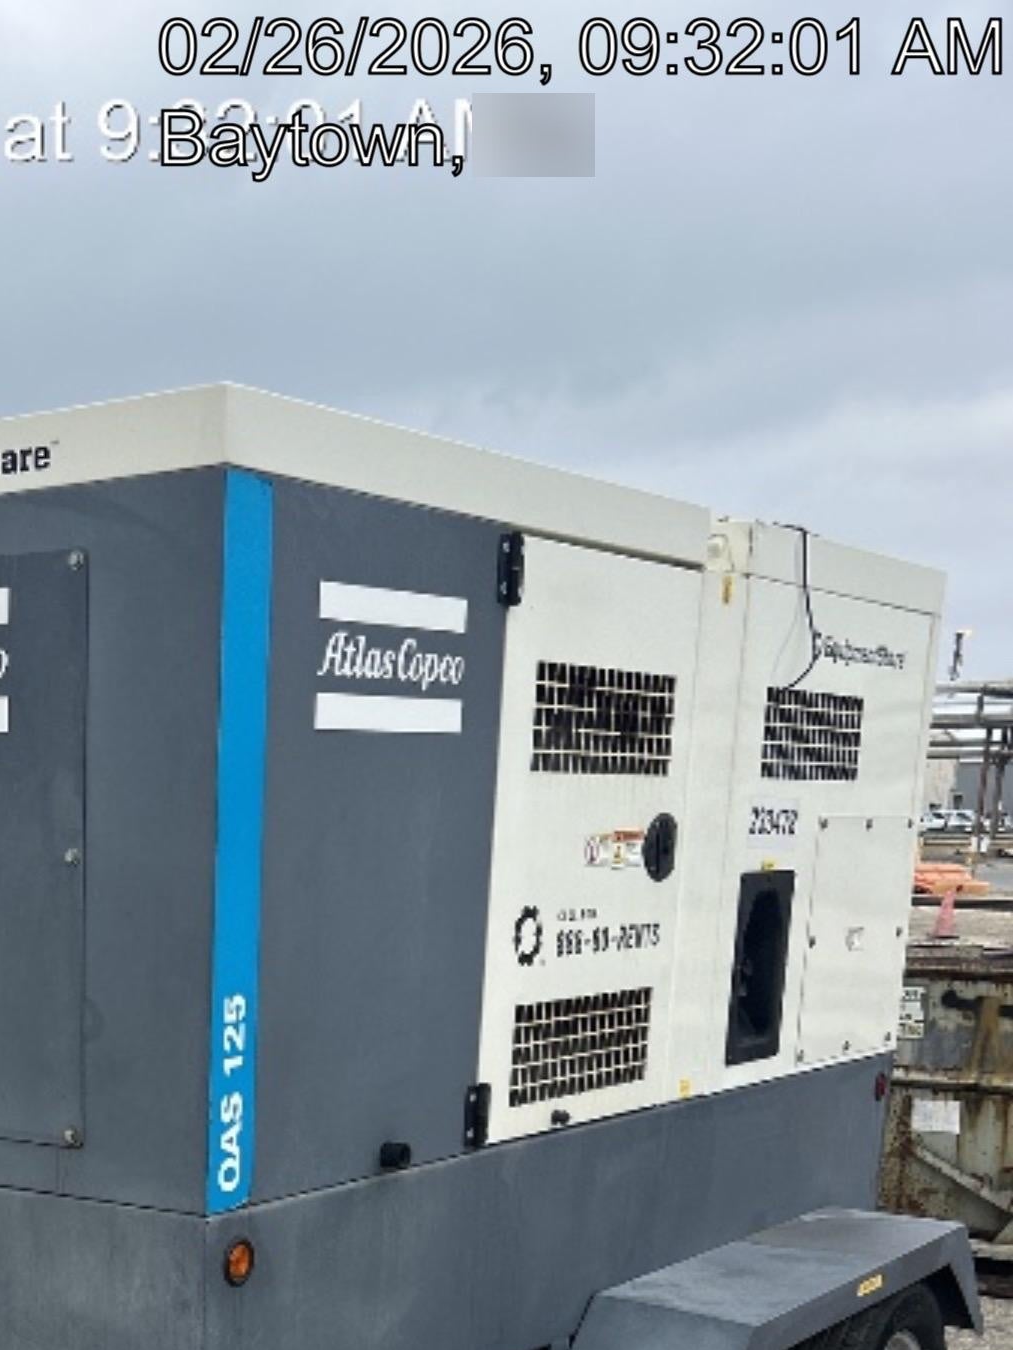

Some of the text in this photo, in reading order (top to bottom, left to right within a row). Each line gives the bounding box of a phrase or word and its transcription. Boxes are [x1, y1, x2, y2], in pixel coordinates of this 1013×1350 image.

[316, 630, 465, 691] Atlas Copco
[217, 993, 247, 1193] QAS 125
